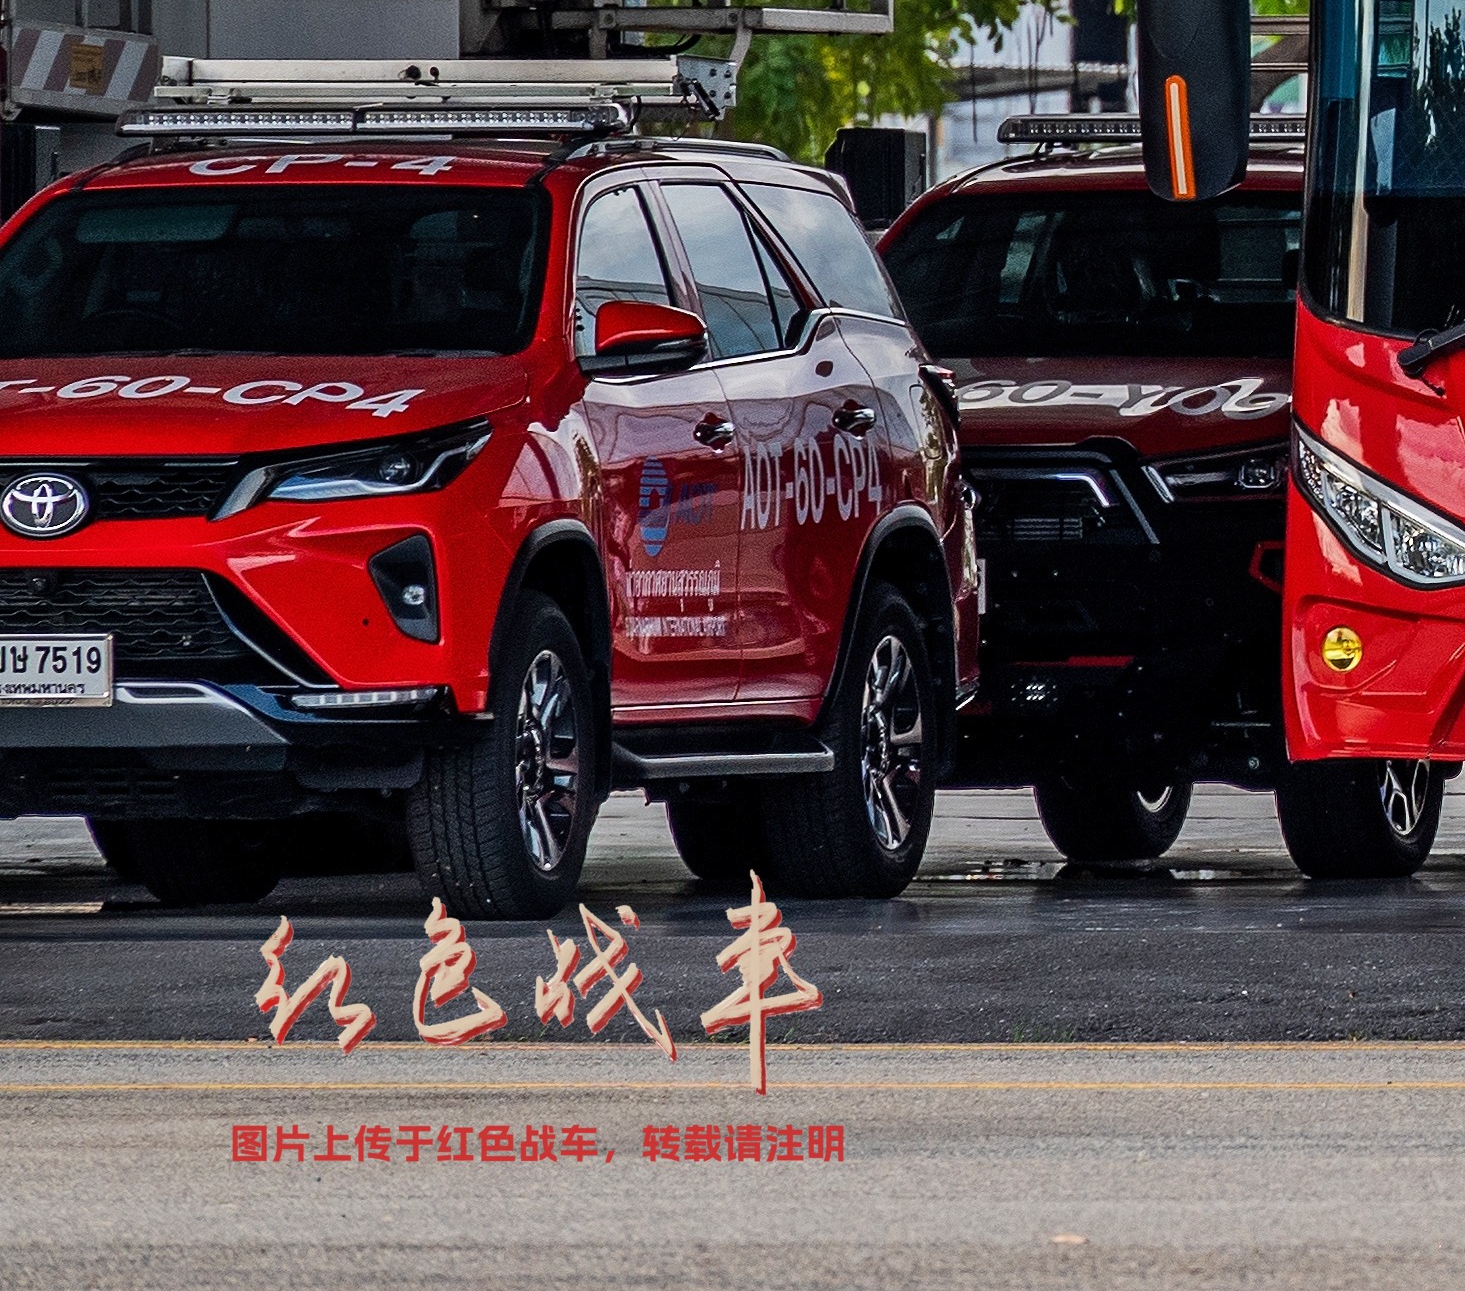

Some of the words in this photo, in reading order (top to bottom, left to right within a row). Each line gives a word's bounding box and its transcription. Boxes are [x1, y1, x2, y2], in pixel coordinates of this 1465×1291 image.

[188, 153, 459, 177] CP-4
[740, 430, 883, 531] AOT-60-CP4
[35, 645, 102, 675] 7519
